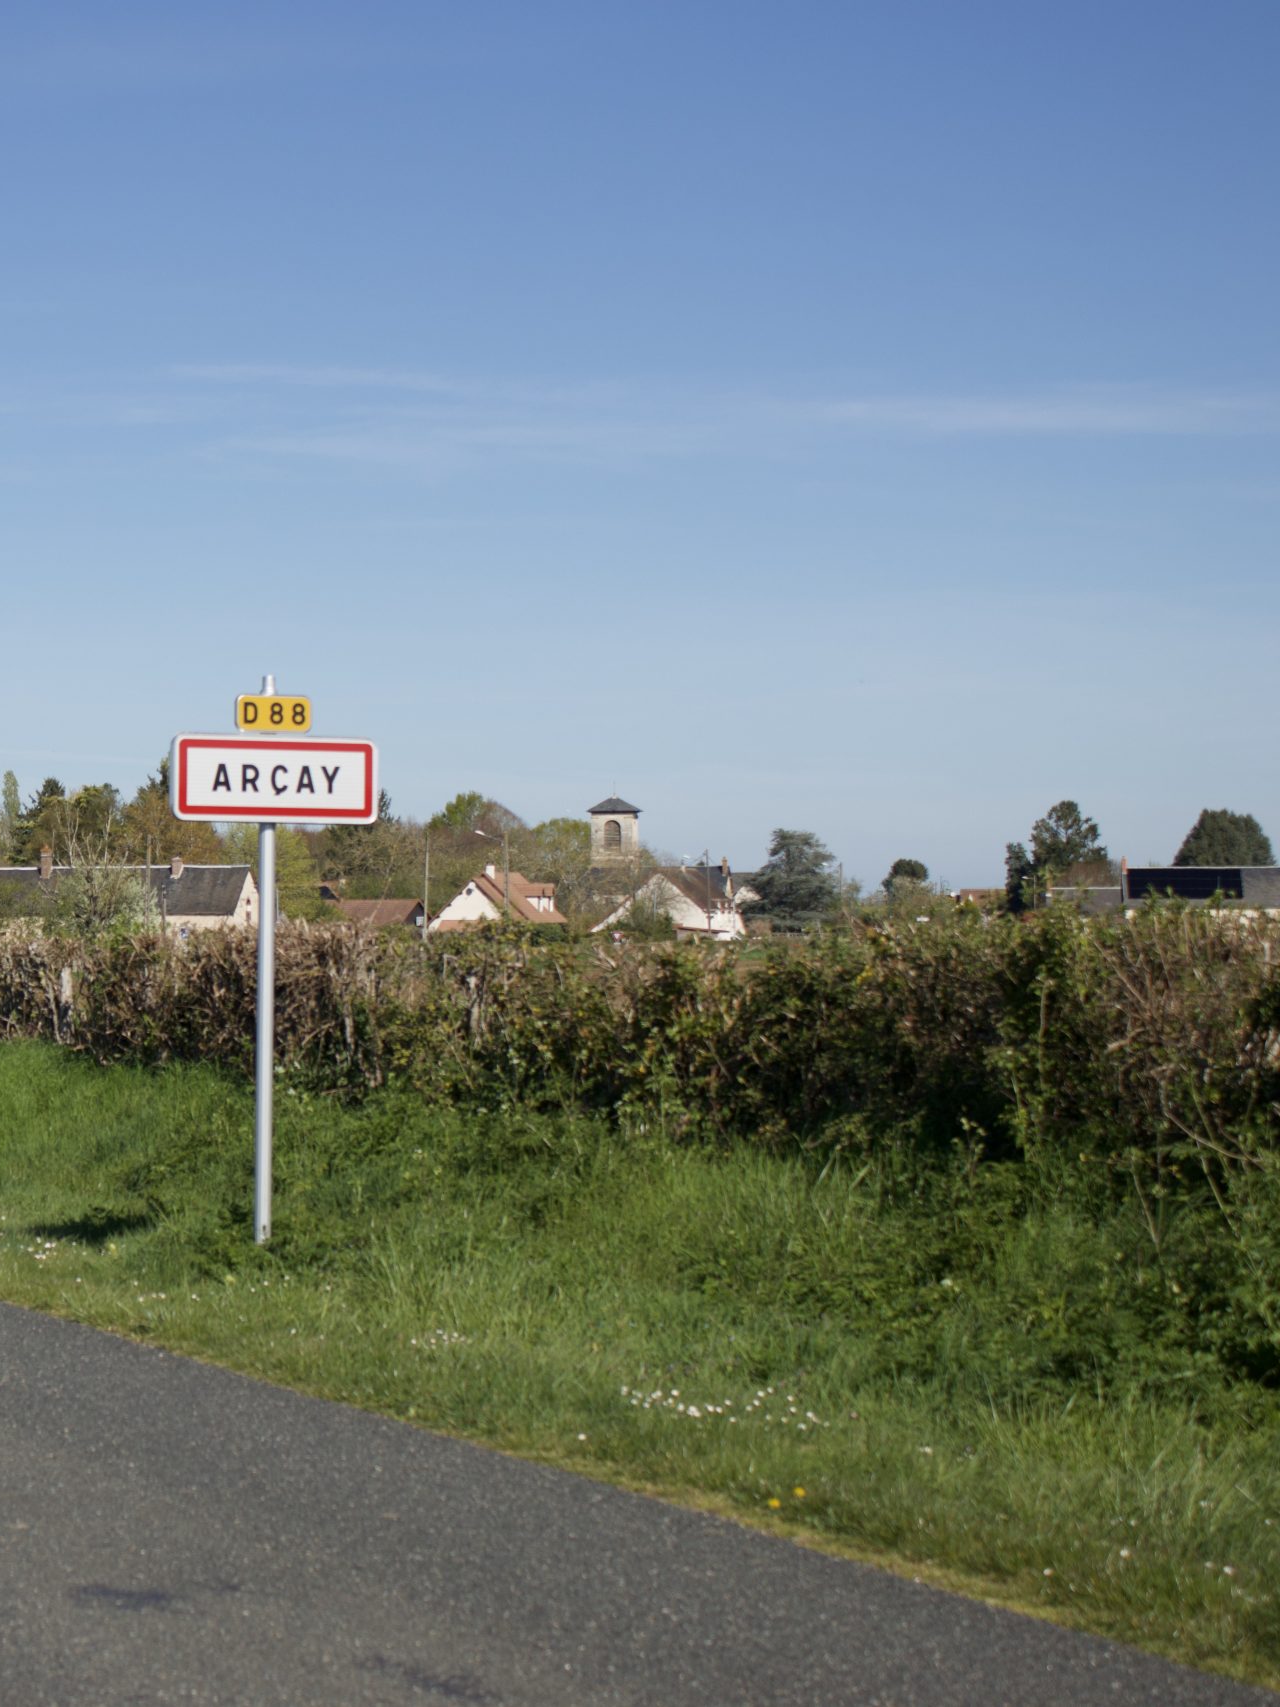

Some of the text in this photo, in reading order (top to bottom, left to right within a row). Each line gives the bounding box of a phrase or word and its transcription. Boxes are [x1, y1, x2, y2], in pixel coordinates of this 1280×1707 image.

[243, 702, 306, 725] D 88
[212, 763, 340, 796] ARÇAY
